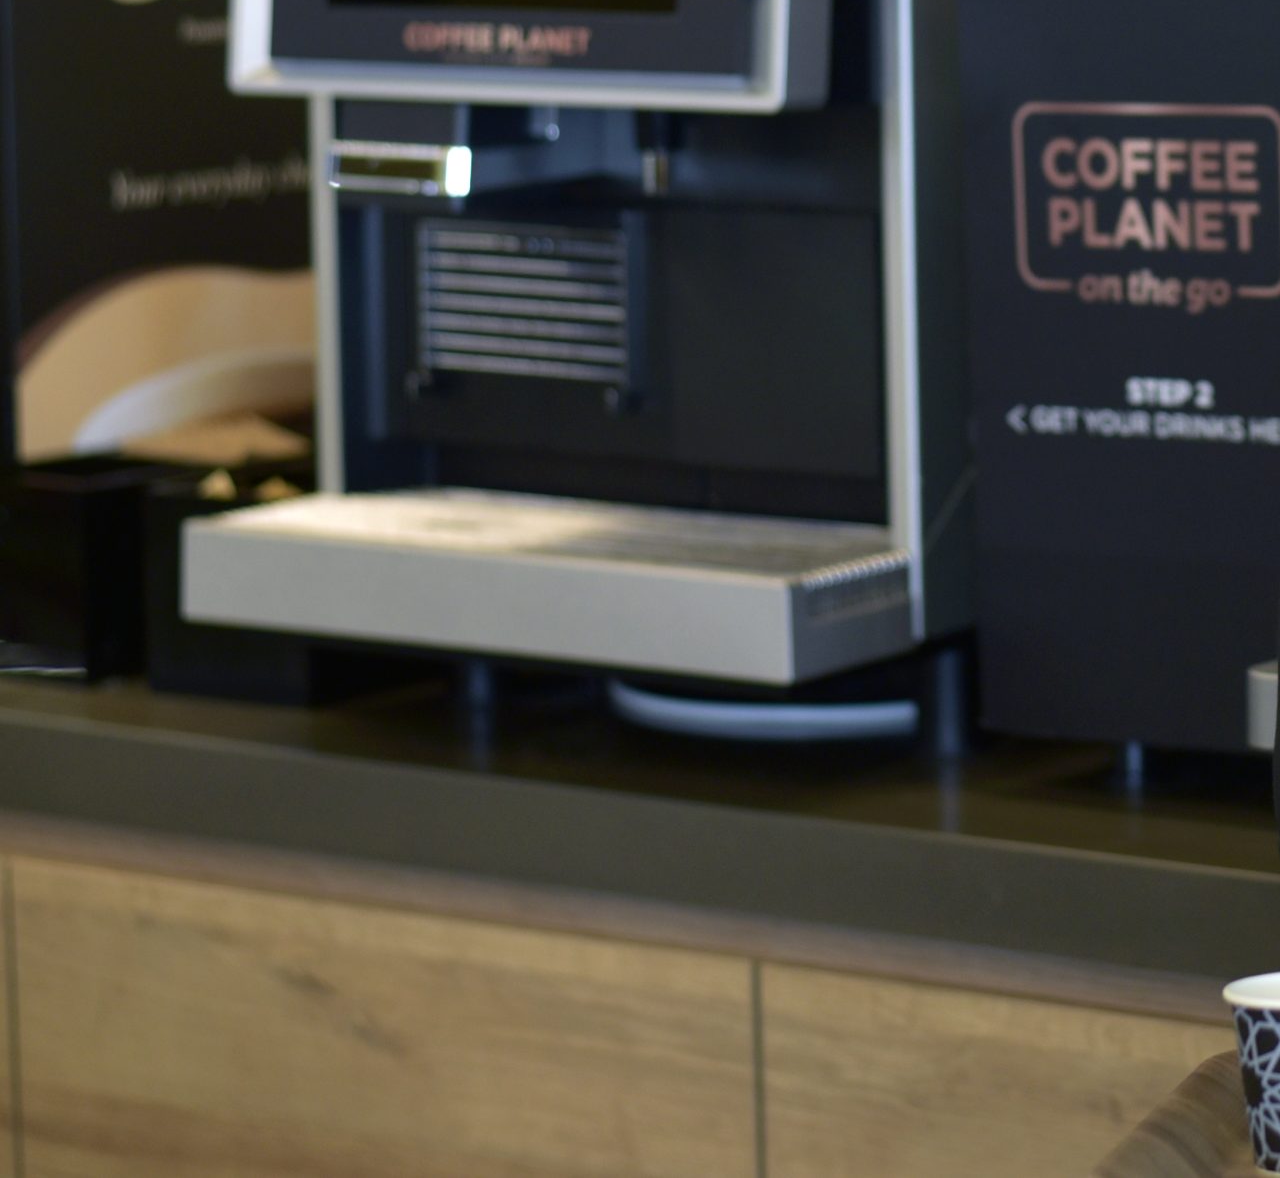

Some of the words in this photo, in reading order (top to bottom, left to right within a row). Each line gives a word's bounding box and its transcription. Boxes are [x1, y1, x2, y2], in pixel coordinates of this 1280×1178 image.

[1042, 137, 1260, 192] COFFEE
[1048, 195, 1260, 252] PLANET
[1077, 274, 1123, 302] on
[1127, 268, 1183, 307] the
[1186, 278, 1233, 314] go
[1126, 376, 1193, 407] STEP
[1195, 379, 1214, 409] 2
[1030, 405, 1079, 434] GET
[1084, 409, 1150, 438] YOUR
[1154, 412, 1246, 444] DRINKS
